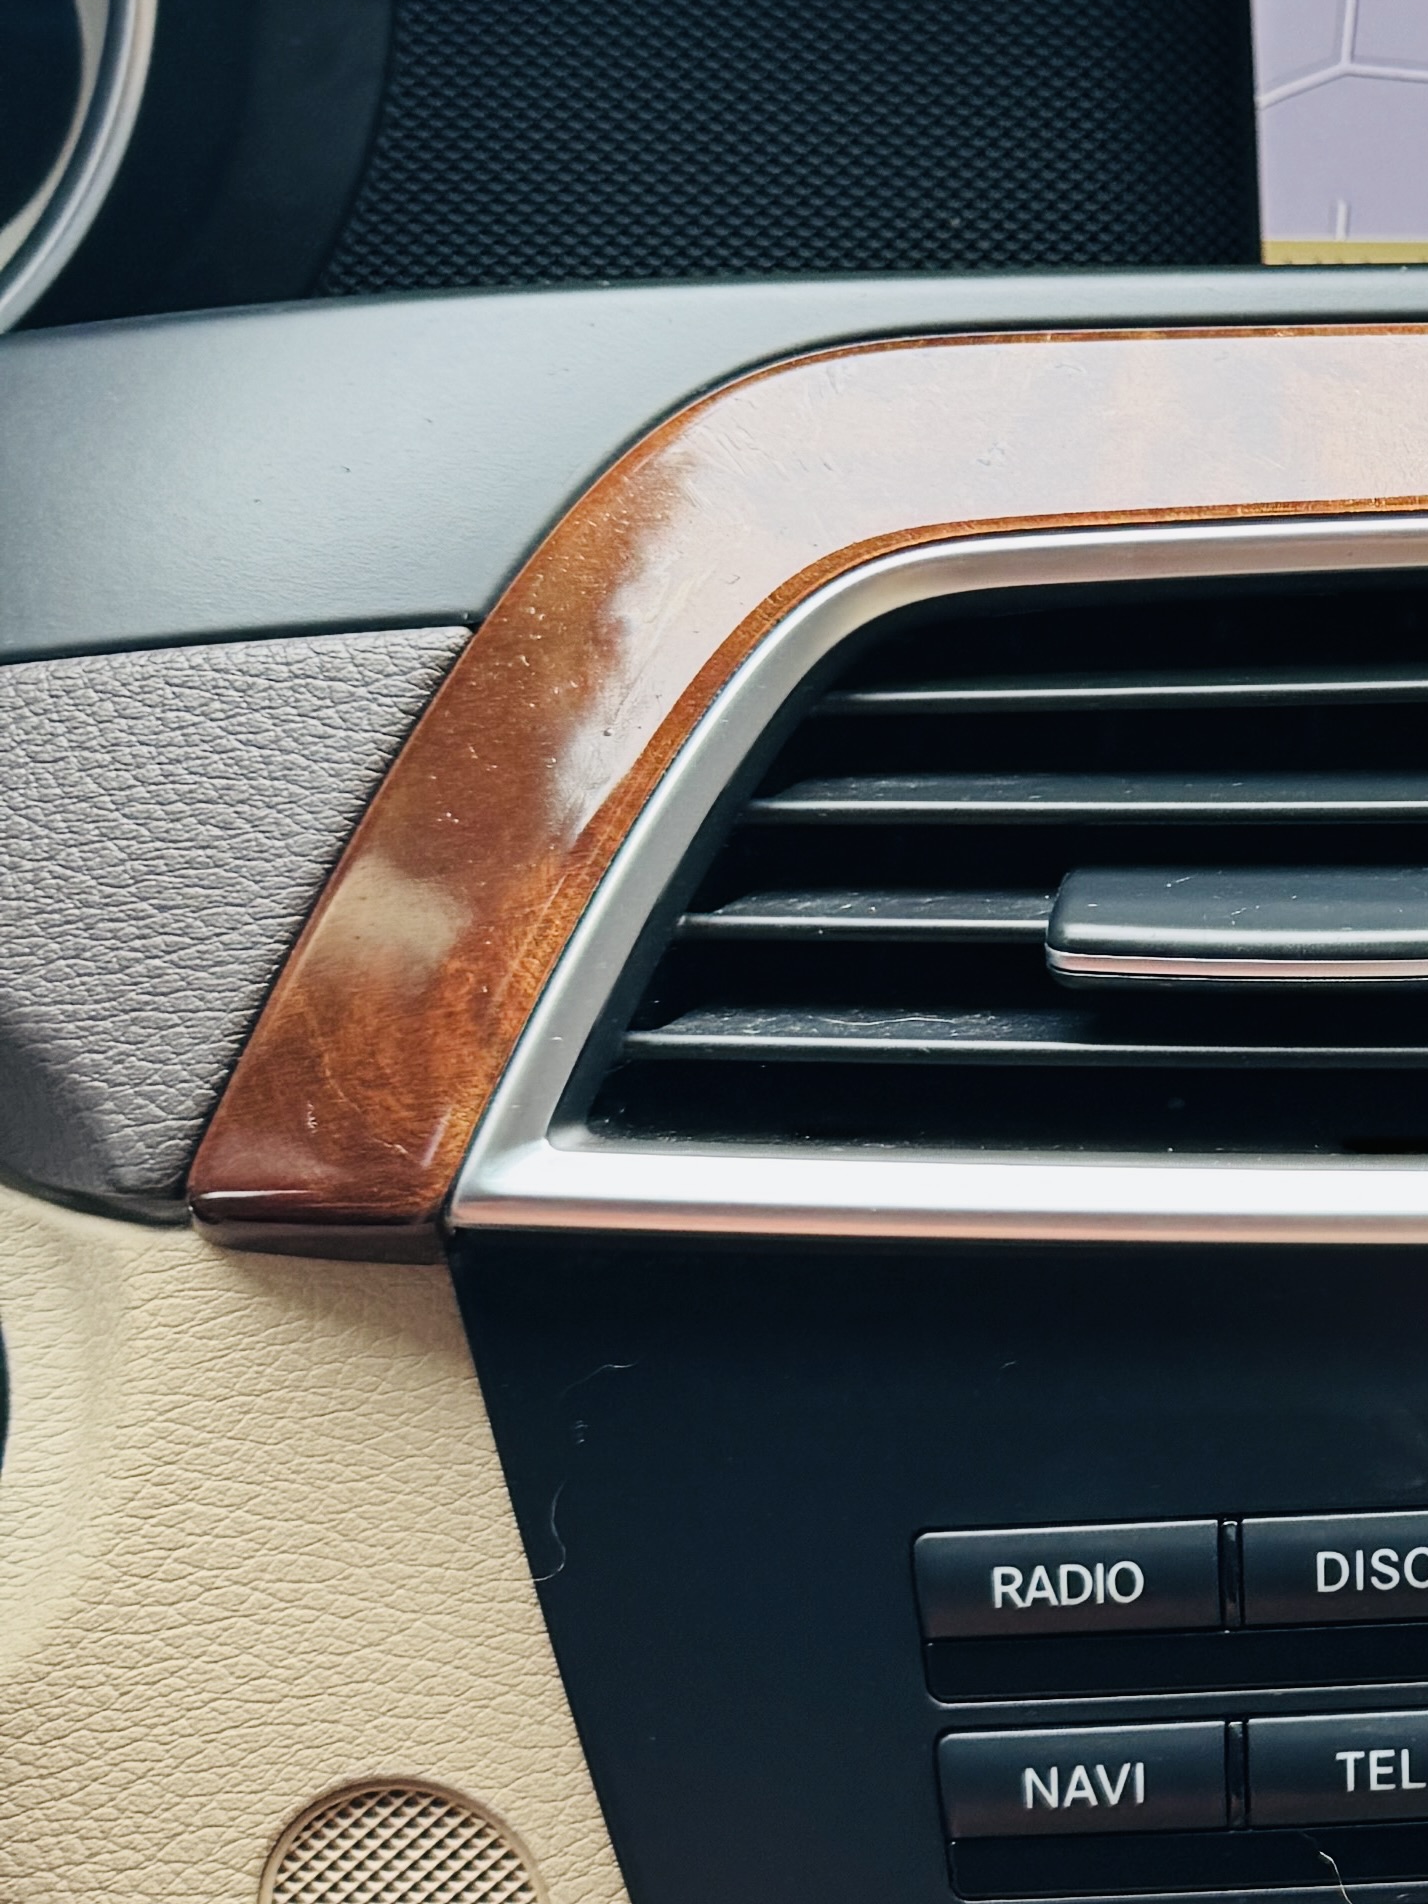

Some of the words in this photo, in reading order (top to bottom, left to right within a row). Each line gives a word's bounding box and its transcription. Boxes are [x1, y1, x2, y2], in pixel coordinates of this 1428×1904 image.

[992, 1561, 1144, 1608] RADIO
[1023, 1762, 1144, 1808] NAVI
[1336, 1749, 1426, 1791] TEL
